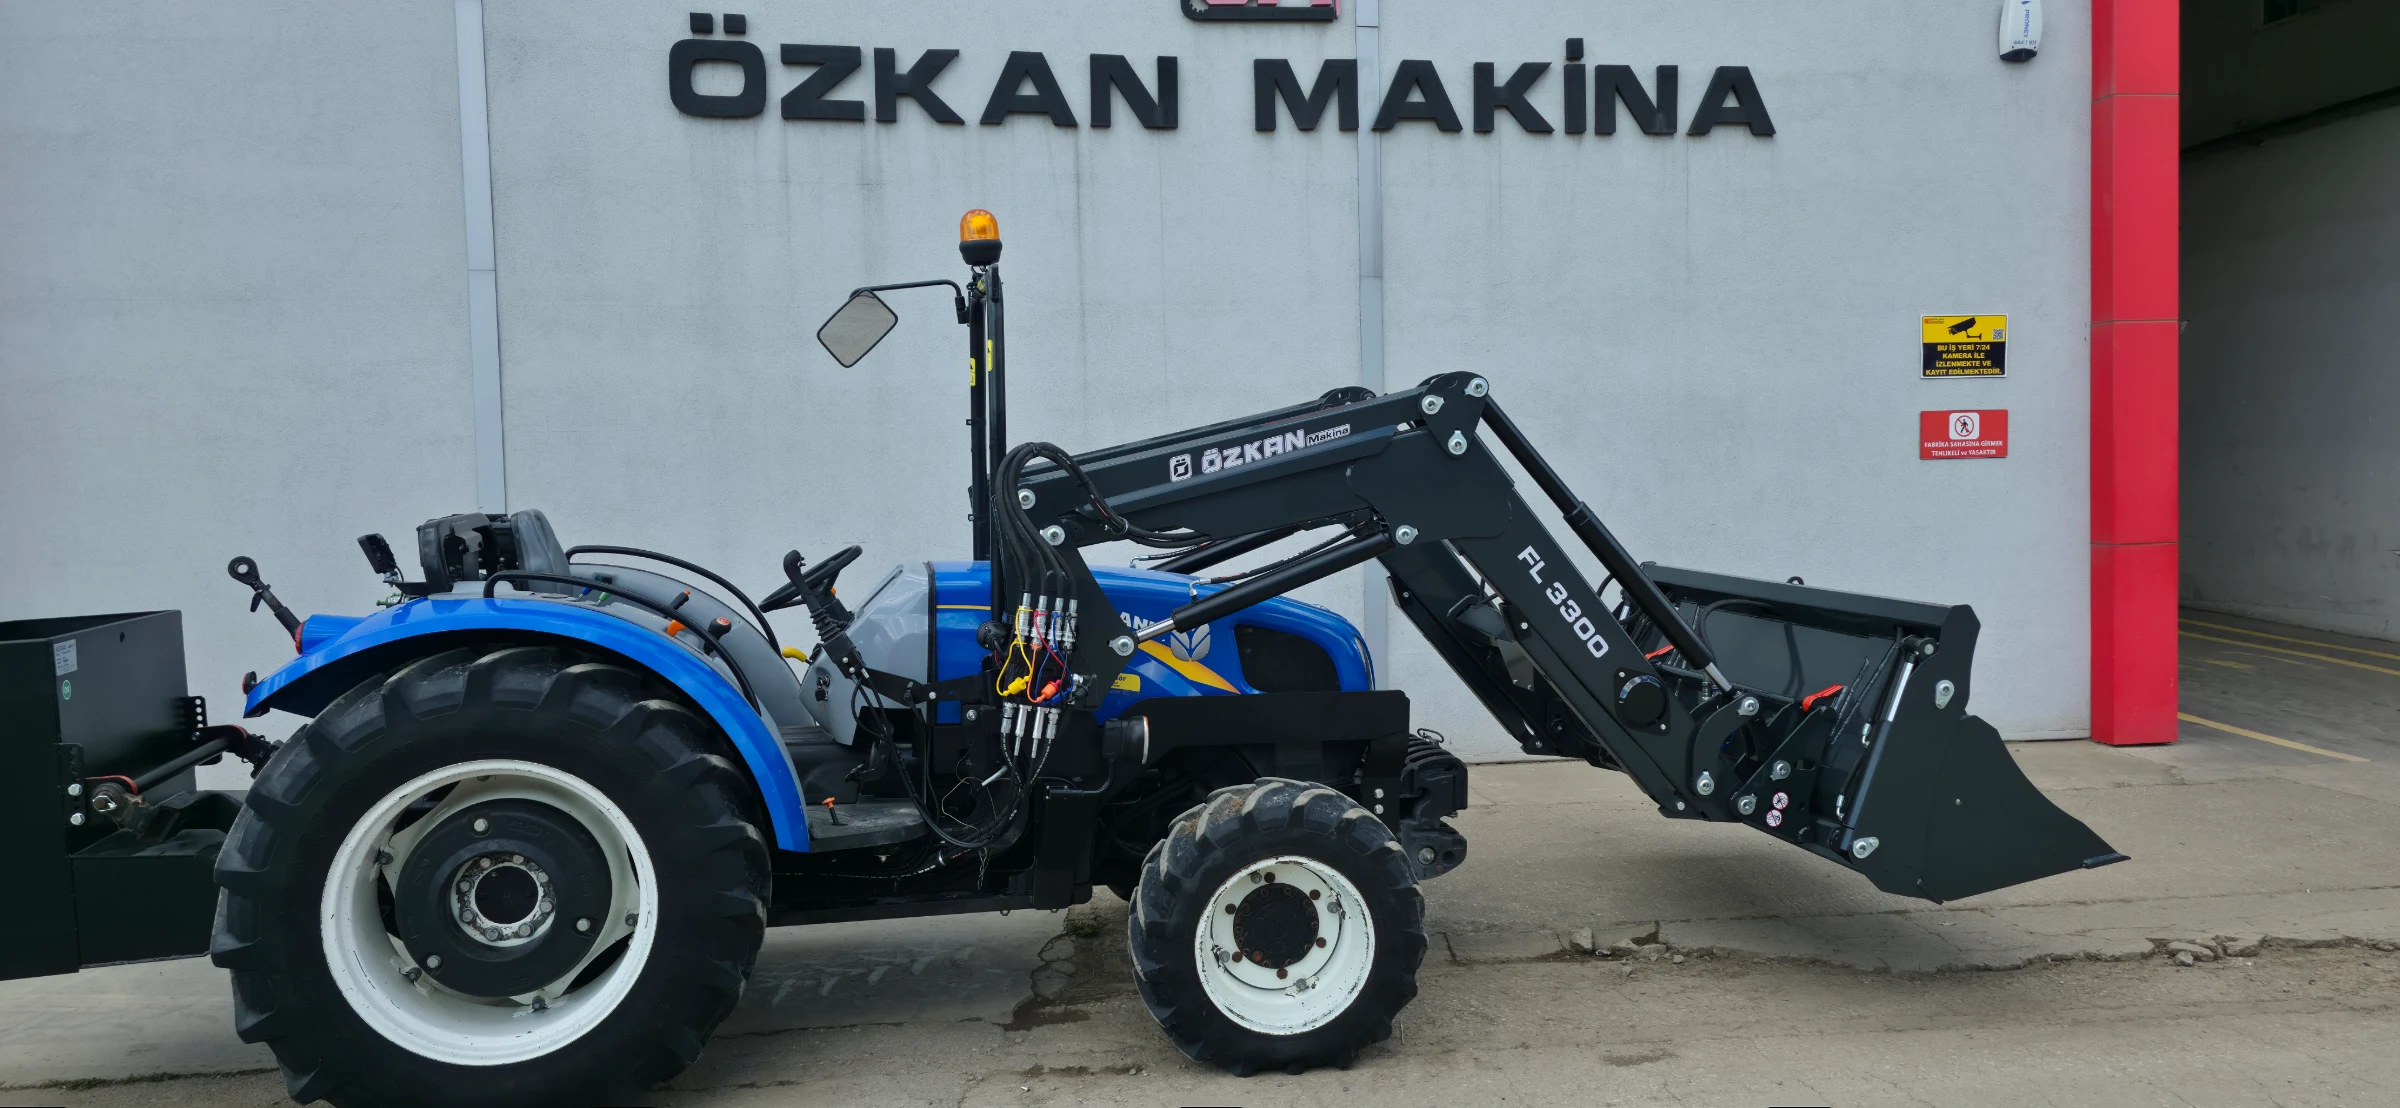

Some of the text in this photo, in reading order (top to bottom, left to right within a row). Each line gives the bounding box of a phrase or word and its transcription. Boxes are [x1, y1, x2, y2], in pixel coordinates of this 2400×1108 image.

[669, 12, 1777, 136] ÖZKAN MAKİNA
[1949, 344, 1957, 352] İŞ
[1948, 367, 2002, 375] EDİLMEKTEDİR.
[1980, 439, 2003, 447] GİRMEK
[1201, 428, 1306, 474] ÖZKAN
[1308, 425, 1350, 445] Makina
[1931, 449, 1960, 457] TEHLİKELİ
[1517, 545, 1609, 658] FL 3300
